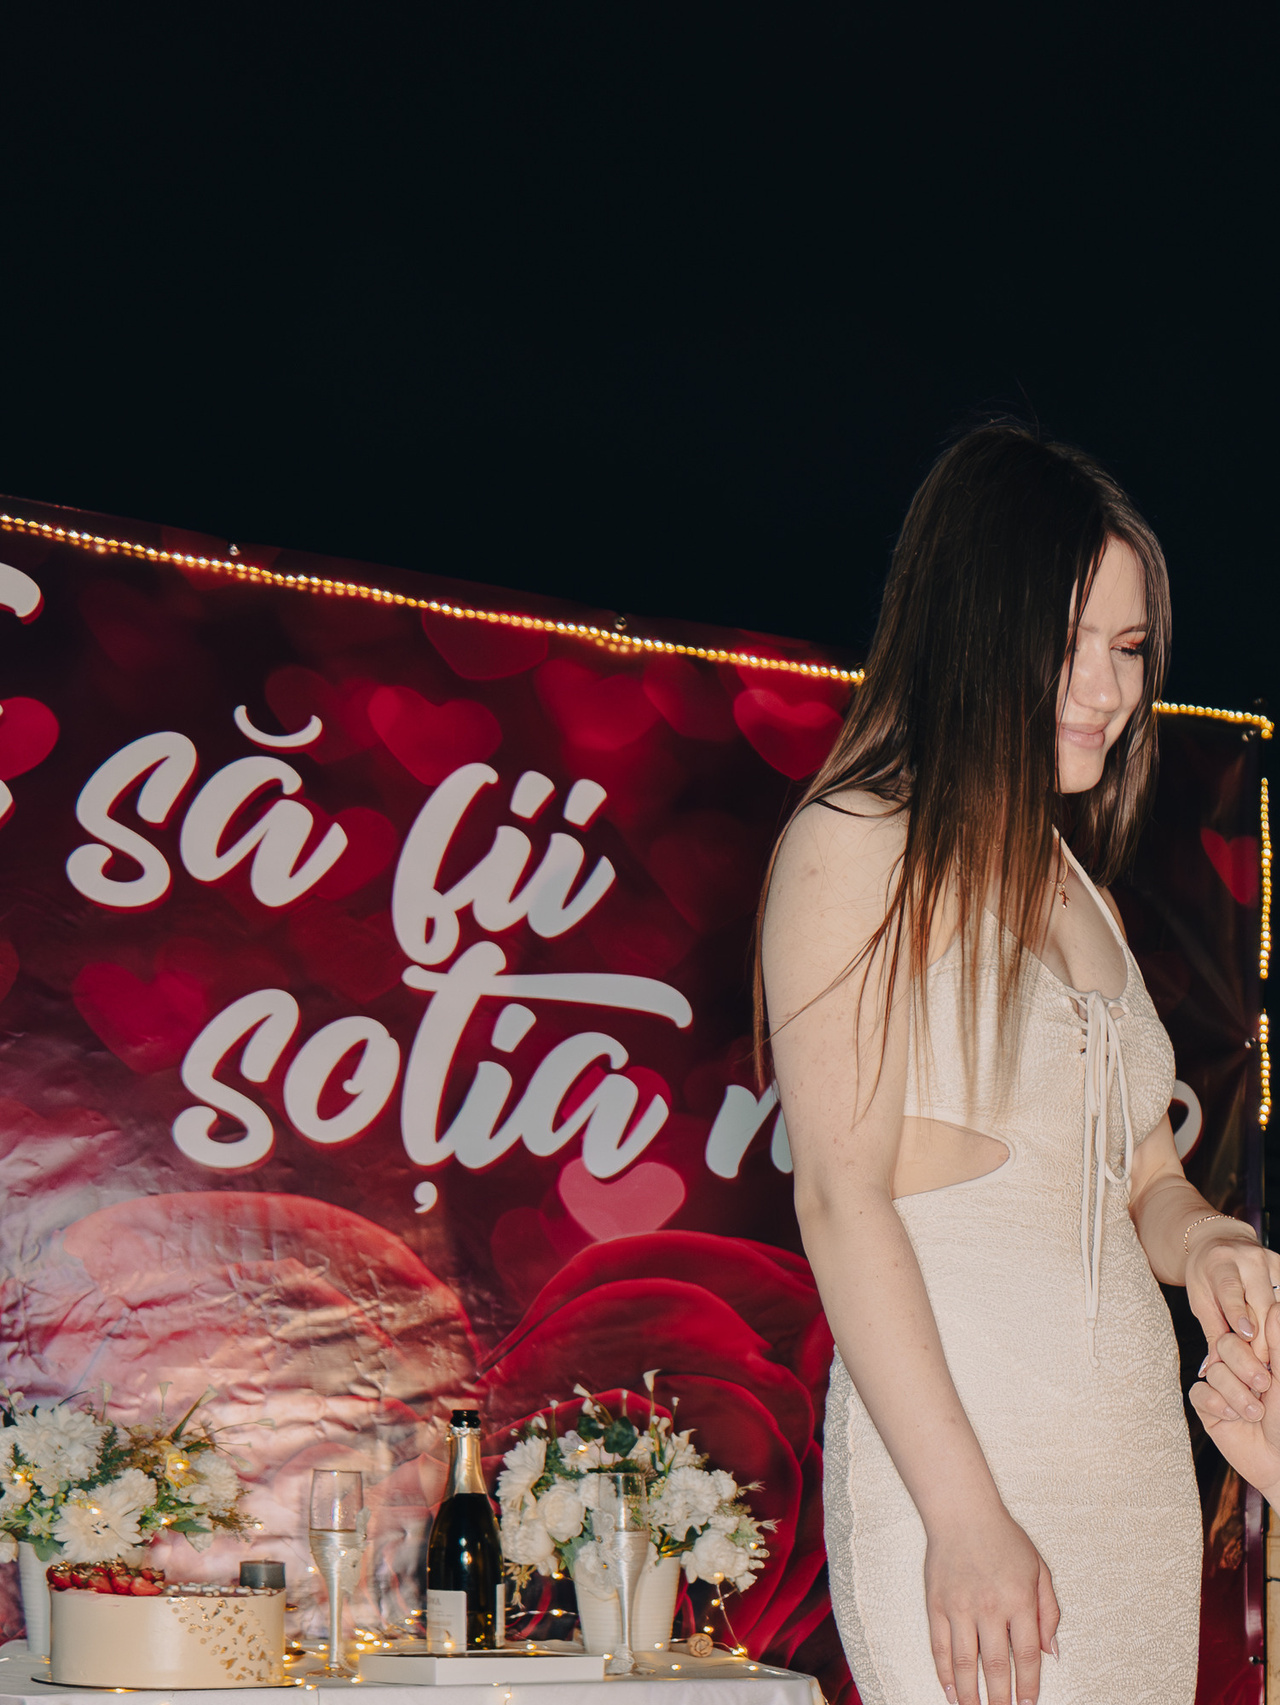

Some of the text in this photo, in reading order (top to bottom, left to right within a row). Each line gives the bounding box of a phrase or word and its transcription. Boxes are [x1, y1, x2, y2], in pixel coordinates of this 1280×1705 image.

[67, 704, 616, 965] să fii
[173, 941, 693, 1213] soția
